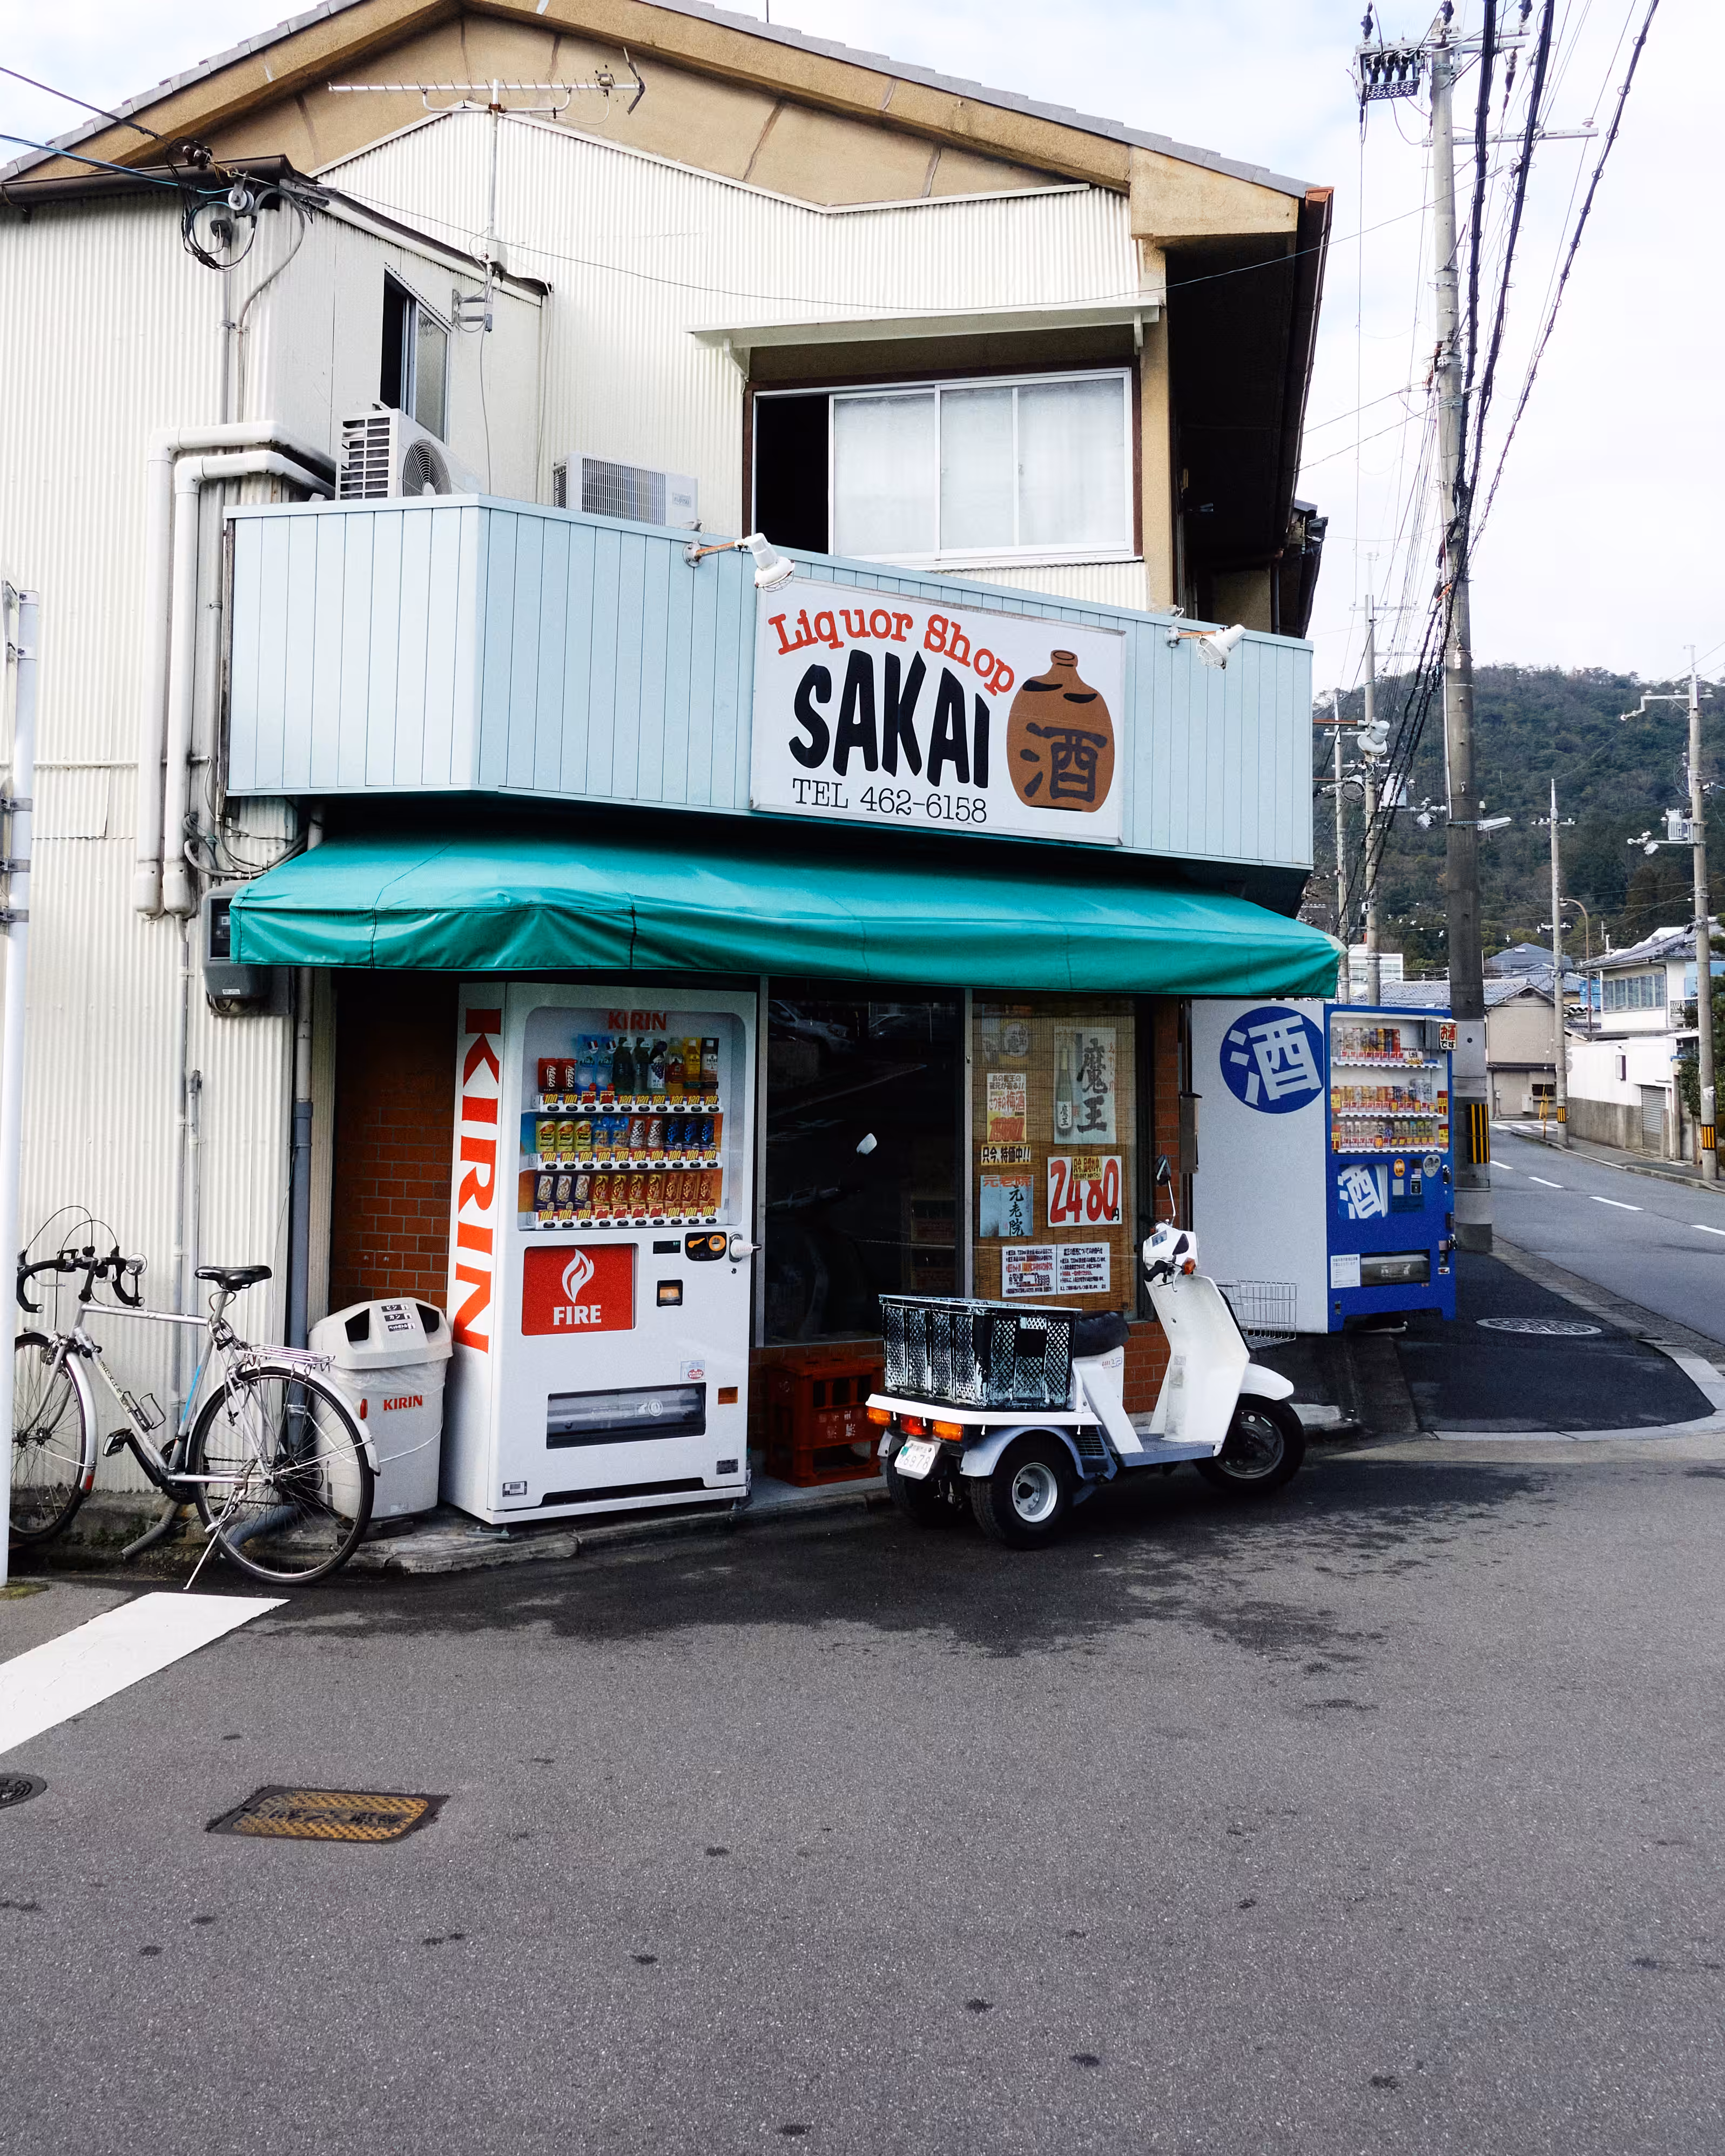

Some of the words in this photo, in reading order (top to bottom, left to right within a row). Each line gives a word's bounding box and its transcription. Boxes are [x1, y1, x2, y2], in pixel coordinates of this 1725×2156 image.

[768, 609, 913, 655] Liquor
[923, 614, 1015, 696] Shop
[789, 649, 990, 789] SAKAI
[1020, 722, 1107, 803] 酒
[792, 778, 848, 809] TEL
[860, 786, 987, 823] 462-6158
[608, 1010, 667, 1030] KIRIN
[1440, 1025, 1457, 1041] お酒
[1440, 1040, 1456, 1048] です
[1228, 1015, 1322, 1106] 酒
[548, 1065, 556, 1087] Mets
[544, 1094, 558, 1104] 100
[564, 1094, 577, 1104] 100
[543, 1151, 556, 1162] 100
[562, 1151, 575, 1162] 100
[580, 1151, 592, 1162] 100
[598, 1151, 611, 1161] 100
[616, 1151, 629, 1161] 100
[634, 1150, 646, 1161] 100
[651, 1150, 664, 1161] 100
[669, 1150, 681, 1161] 100
[686, 1150, 699, 1161] 100
[703, 1150, 716, 1161] 100
[453, 1007, 502, 1355] KIRIN
[1338, 1165, 1383, 1219] 酒
[540, 1210, 554, 1221] 100
[559, 1210, 572, 1220] 100
[578, 1209, 591, 1220] 100
[668, 1207, 680, 1217] 100
[685, 1207, 697, 1217] 100
[703, 1206, 715, 1216] 100
[553, 1305, 602, 1325] FIRE
[383, 1395, 423, 1411] KIRIN
